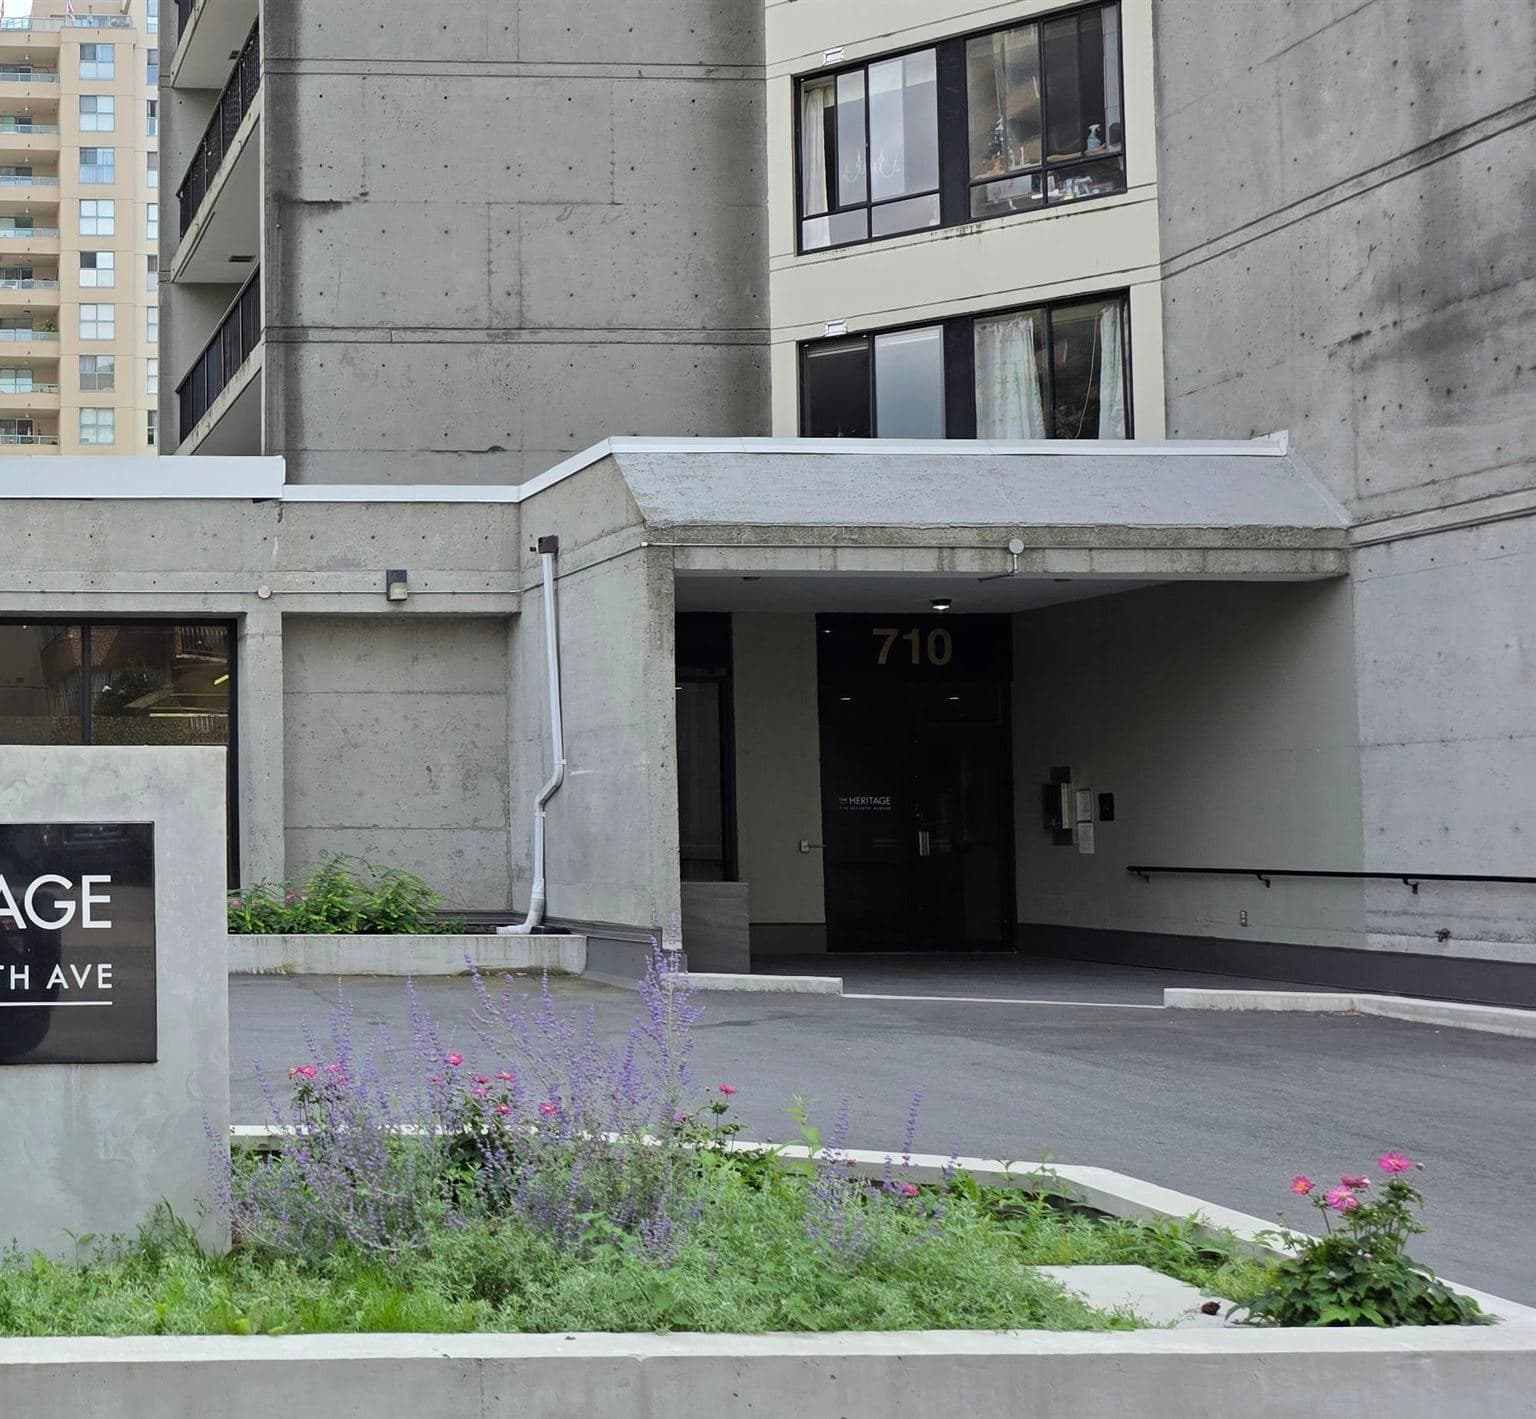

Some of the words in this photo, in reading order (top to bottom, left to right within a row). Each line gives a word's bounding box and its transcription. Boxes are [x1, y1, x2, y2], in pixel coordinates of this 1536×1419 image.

[872, 628, 953, 666] 710
[849, 796, 892, 805] HERITAGE
[46, 963, 113, 990] AVE
